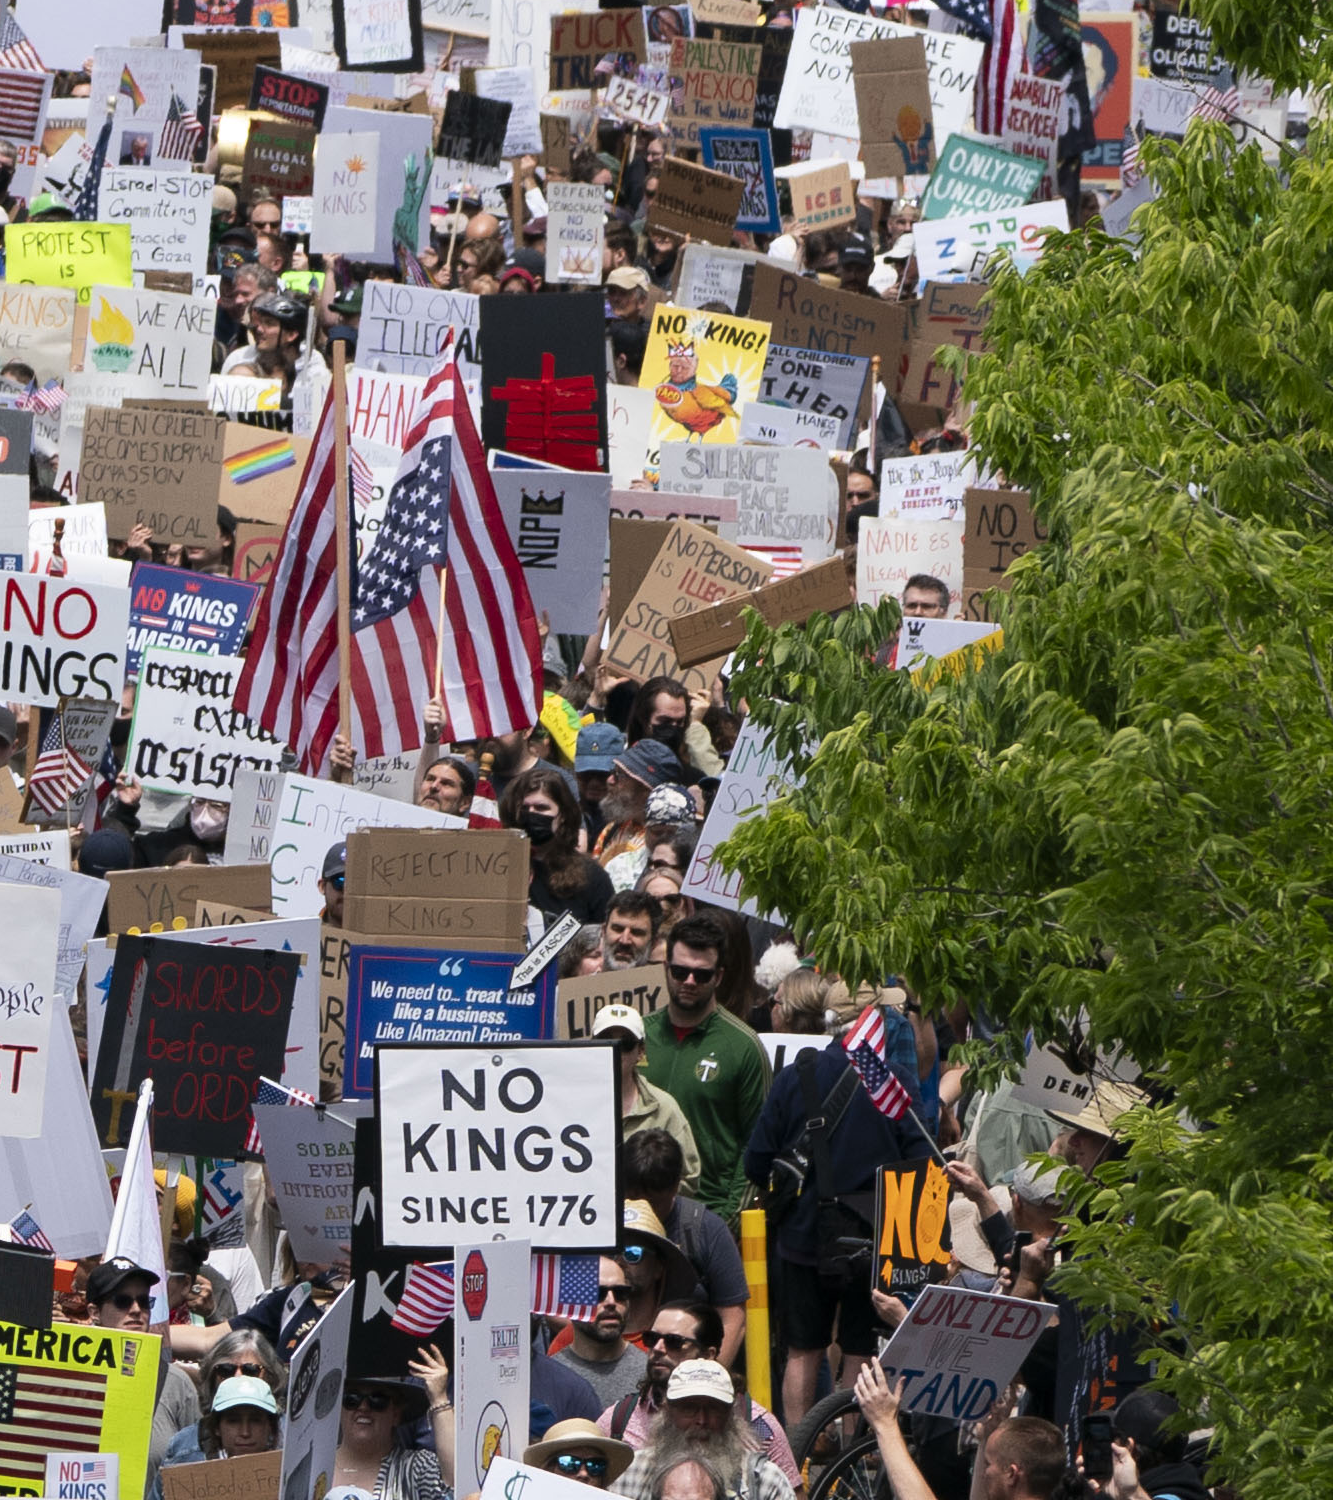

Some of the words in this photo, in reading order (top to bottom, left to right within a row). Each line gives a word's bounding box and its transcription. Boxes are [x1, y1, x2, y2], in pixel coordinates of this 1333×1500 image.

[21, 232, 110, 257] PROTEST
[59, 265, 74, 278] IS
[135, 298, 172, 329] WE
[177, 304, 212, 335] ARE
[657, 315, 686, 334] NO
[704, 321, 767, 352] KING!
[138, 340, 196, 387] ALL
[681, 448, 777, 482] SILENCE
[4, 579, 98, 640] NO
[442, 1068, 544, 1112] NO
[402, 1122, 593, 1173] KINGS
[402, 1196, 509, 1225] SINCE
[527, 1196, 597, 1227] 1776
